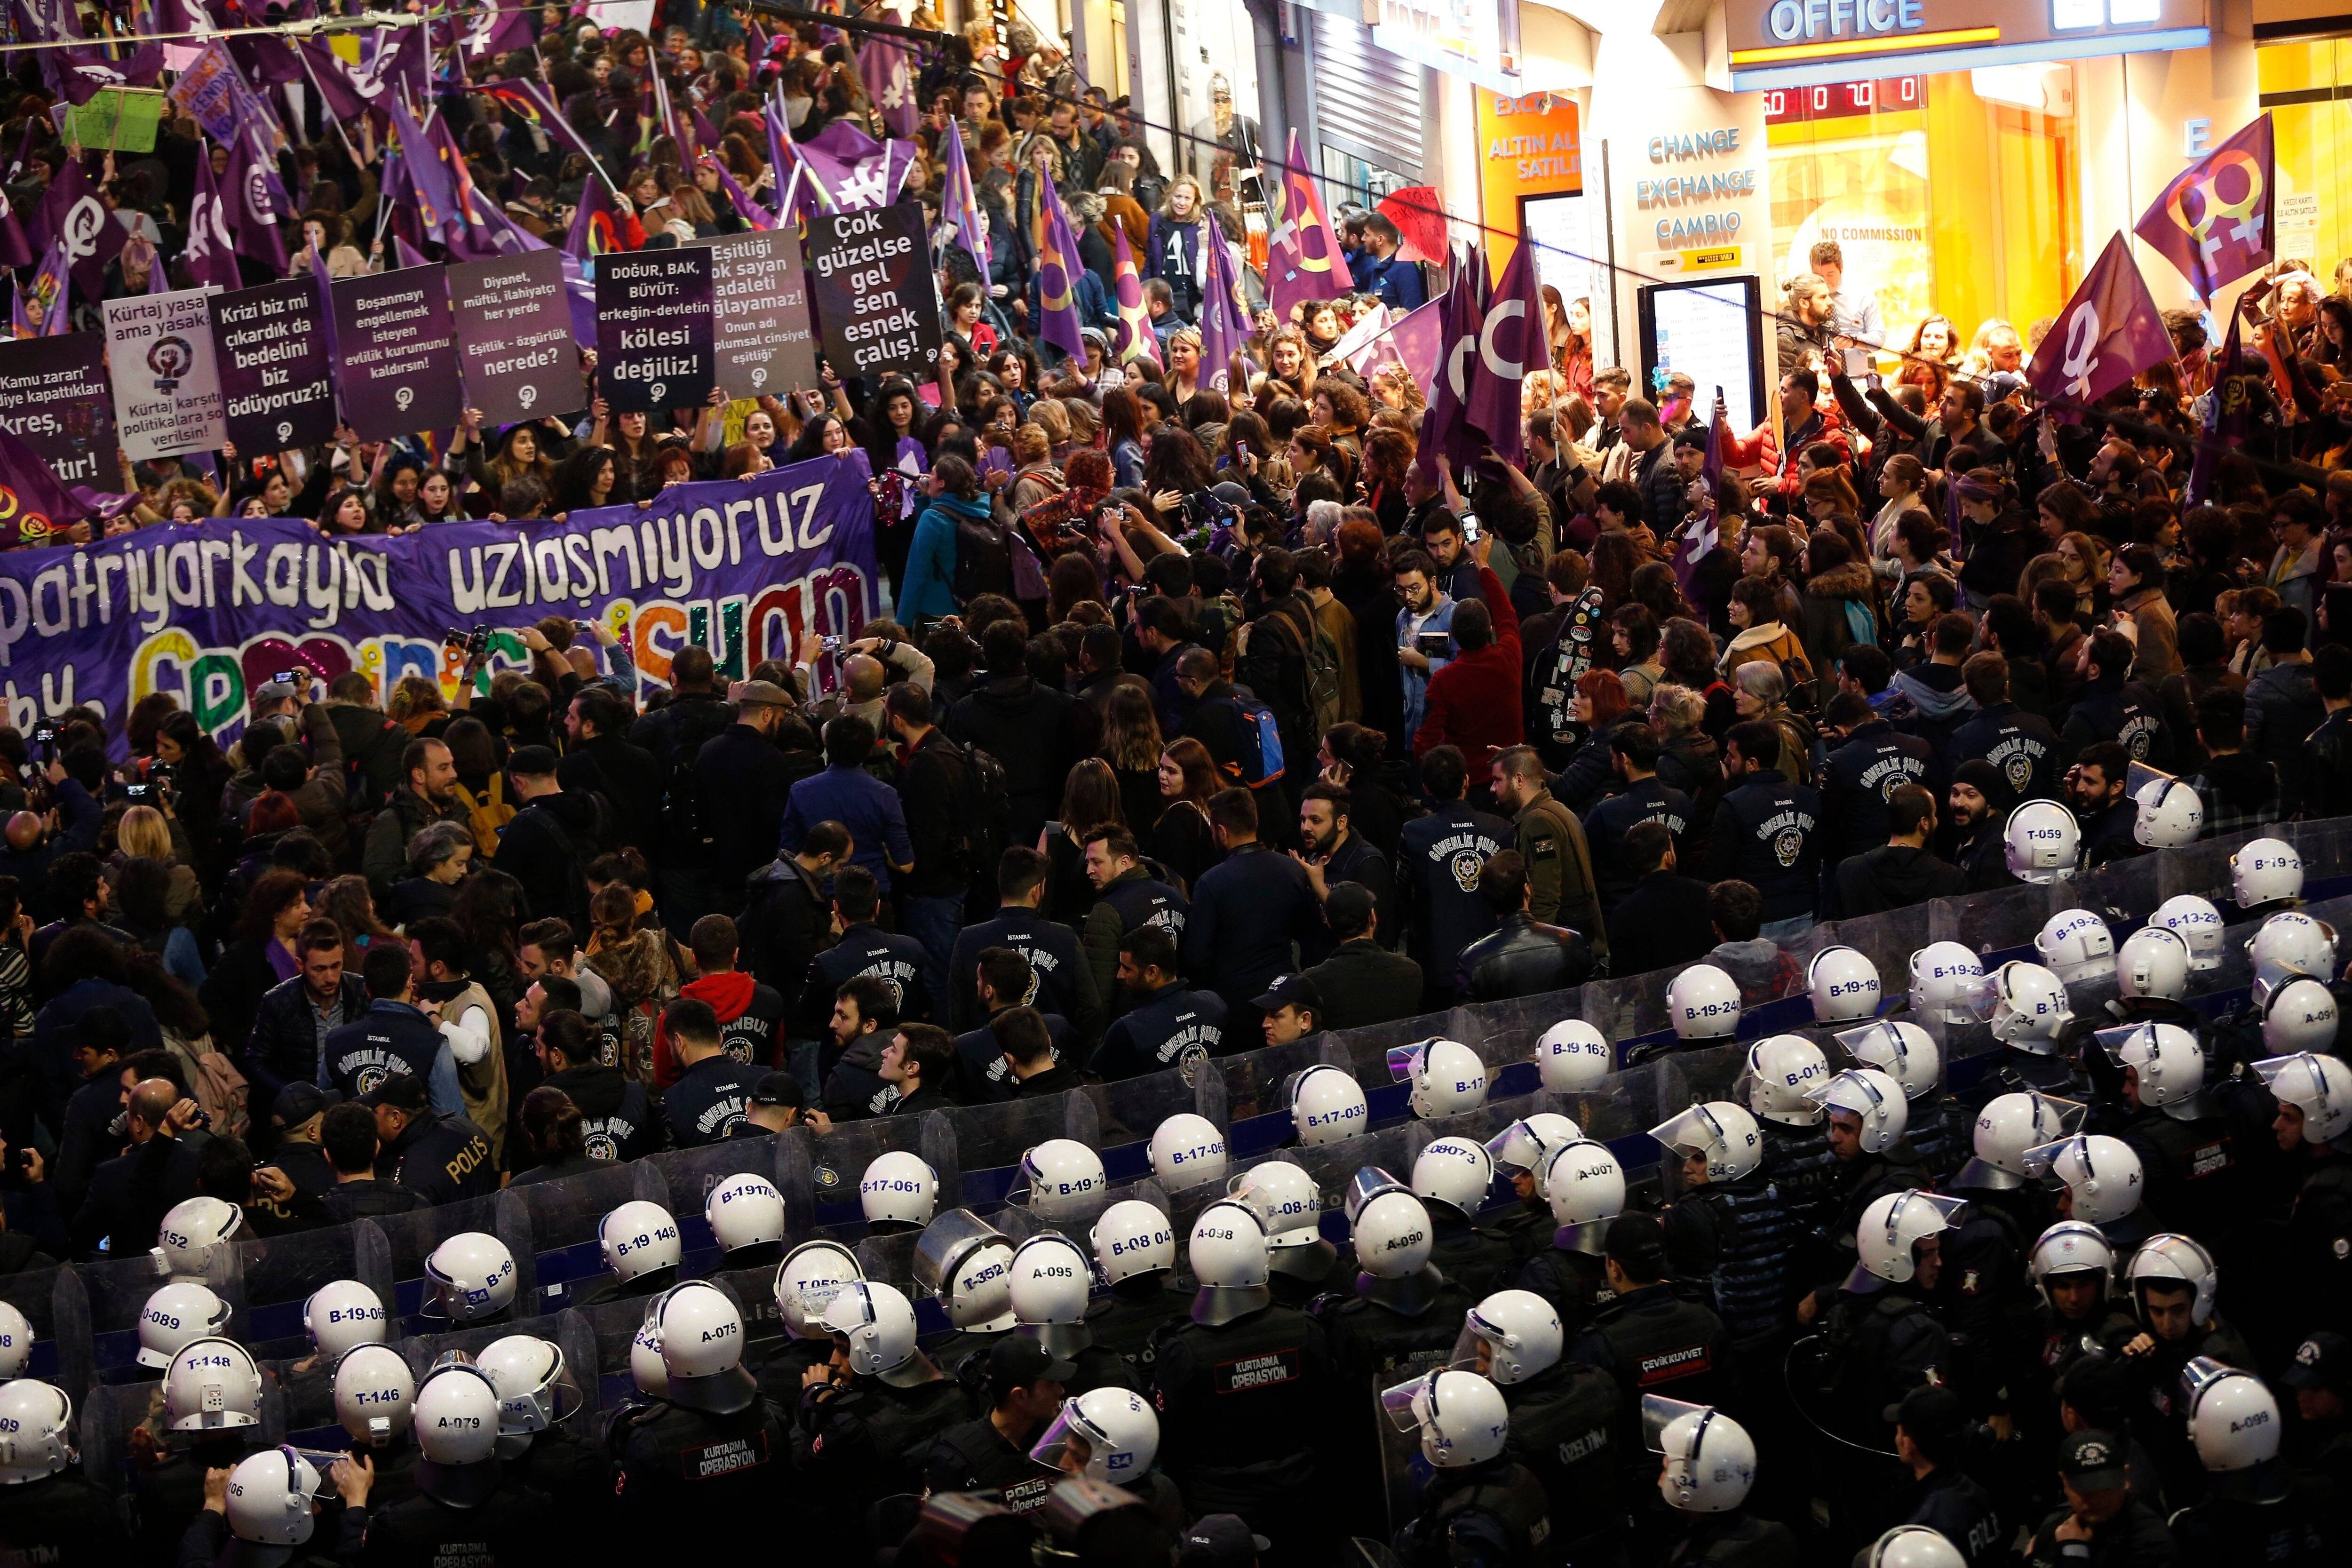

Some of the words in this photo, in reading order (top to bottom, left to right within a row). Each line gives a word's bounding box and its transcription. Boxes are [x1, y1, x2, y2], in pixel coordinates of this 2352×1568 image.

[1771, 0, 1924, 40] OFFICE
[1489, 135, 1545, 159] ALTIN
[1648, 128, 1740, 157] CHANGE
[1637, 169, 1756, 201] EXCHANGE
[2285, 207, 2298, 216] ALTIN
[833, 210, 884, 244] Çok
[1656, 211, 1741, 239] CAMBIO
[1821, 228, 1837, 240] NO
[1842, 228, 1923, 241] COMMISSION
[712, 239, 773, 262] Eşitliği
[816, 235, 913, 278] güzelse
[484, 271, 531, 290] Diyanet,
[612, 263, 663, 280] DOĞUR,
[667, 261, 700, 276] BAK,
[712, 262, 731, 279] ok
[736, 259, 787, 281] sayan
[850, 262, 891, 295] gel
[463, 293, 502, 310] müftü,
[504, 283, 556, 303] ilahiyatçı
[629, 283, 680, 299] BÜYÜT:
[716, 275, 776, 297] adaleti
[221, 302, 258, 325] Krizi
[261, 298, 285, 317] biz
[287, 292, 309, 310] mi
[356, 289, 424, 311] Boşanmayı
[484, 307, 504, 321] her
[507, 301, 541, 318] yerde
[713, 289, 803, 319] ğlayamaz!
[853, 290, 898, 316] sen
[109, 303, 162, 324] Kürtaj
[356, 305, 429, 329] engellemek
[599, 301, 710, 322] erkeğin-devletin
[115, 323, 151, 340] ama
[225, 324, 288, 351] çıkardık
[292, 318, 312, 333] da
[373, 326, 418, 344] isteyen
[725, 319, 756, 334] Onun
[758, 317, 777, 329] adı
[844, 308, 920, 343] esnek
[468, 339, 506, 358] Eşitlik
[516, 328, 568, 349] özgürlük
[620, 325, 690, 350] kölesi
[714, 334, 762, 353] plumsal
[765, 328, 810, 348] cinsiyet
[235, 337, 309, 369] bedelini
[345, 346, 382, 367] evlilik
[385, 337, 450, 359] kurumunu
[484, 347, 559, 377] nerede?
[853, 331, 920, 372] çalış!
[261, 366, 290, 388] biz
[370, 358, 430, 380] kaldırsın!
[613, 355, 699, 383] değiliz!
[0, 373, 40, 390] Kamu
[27, 382, 105, 404] kapattıkları
[228, 380, 330, 418] ödüyoruz?!
[129, 398, 173, 418] Kürtaj
[124, 409, 204, 437] politikalara
[151, 425, 209, 446] verilsin!
[448, 482, 834, 608] uzlaşmıyoruz
[1573, 627, 1590, 639] SRB
[2024, 738, 2047, 760] ŞUBE
[1860, 756, 1900, 788] GÜVENLİK
[1903, 756, 1925, 777] ŞUBE
[1667, 814, 1686, 835] ŞUBE
[1756, 810, 1796, 840] GÜVENLİK
[1797, 812, 1816, 832] ŞUBE
[2027, 828, 2062, 840] T-059
[1428, 832, 1474, 862] GÜVENLİK
[1476, 835, 1500, 857] ŞUBE
[866, 947, 890, 957] İSTANBUL
[1031, 948, 1059, 972] ŞUBE
[894, 960, 916, 982] ŞUBE
[1176, 1011, 1197, 1023] İSTANBUL
[367, 1034, 390, 1043] İSTANBUL
[1157, 1024, 1199, 1063] GÜVENLİK
[1199, 1025, 1222, 1045] ŞUBE
[338, 1047, 385, 1075] GÜVENLİK
[1585, 1043, 1606, 1058] 162
[715, 1082, 740, 1093] İSTANBUL
[696, 1094, 743, 1134] GÜVENLİK
[1308, 1104, 1366, 1127] B-17-033
[607, 1116, 635, 1140] ŞUBE
[1579, 1164, 1613, 1181] A-007
[862, 1179, 922, 1194] B-17-061
[617, 1233, 650, 1257] B-19
[654, 1226, 677, 1242] 148
[1197, 1228, 1233, 1240] A-098
[1386, 1231, 1423, 1251] A-090
[1112, 1234, 1151, 1257] B-08
[963, 1264, 1005, 1292] T-352
[1032, 1267, 1073, 1279] A-095
[469, 1291, 488, 1303] 34
[701, 1322, 738, 1343] A-075
[187, 1355, 231, 1371] T-148
[1236, 1355, 1279, 1373] KURTARMA
[1232, 1366, 1287, 1390] OPERASYON
[355, 1388, 400, 1406] T-146
[437, 1417, 480, 1429] A-079
[2229, 1411, 2270, 1433] A-099
[703, 1438, 747, 1459] KURTARMA
[699, 1449, 756, 1477] OPERASYON
[440, 1543, 487, 1555] KURTARMA
